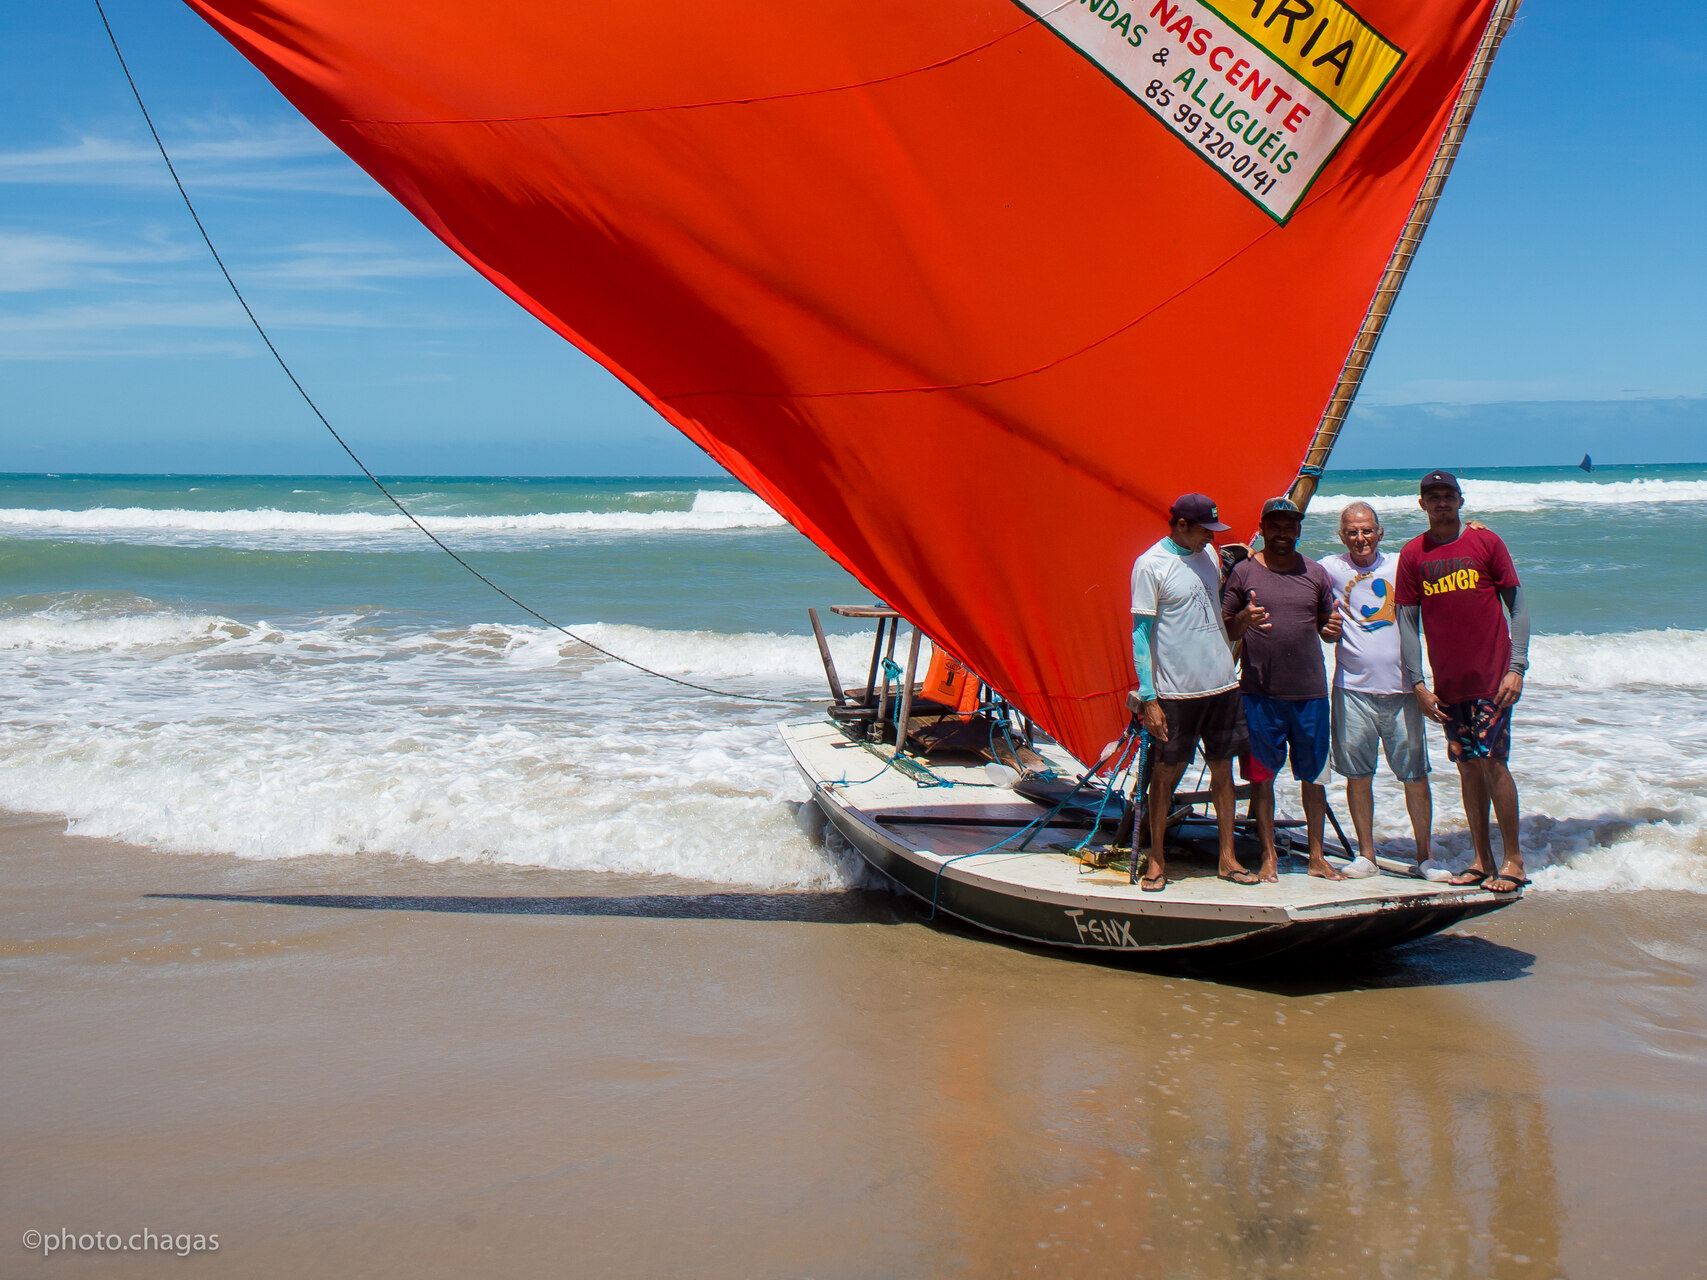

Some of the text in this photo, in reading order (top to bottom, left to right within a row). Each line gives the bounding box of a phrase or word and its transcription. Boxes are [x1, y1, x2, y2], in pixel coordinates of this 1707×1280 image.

[1145, 79, 1278, 196] 85 99720-0141
[1152, 47, 1170, 67] &
[1173, 67, 1299, 174] ALUGUÉIS
